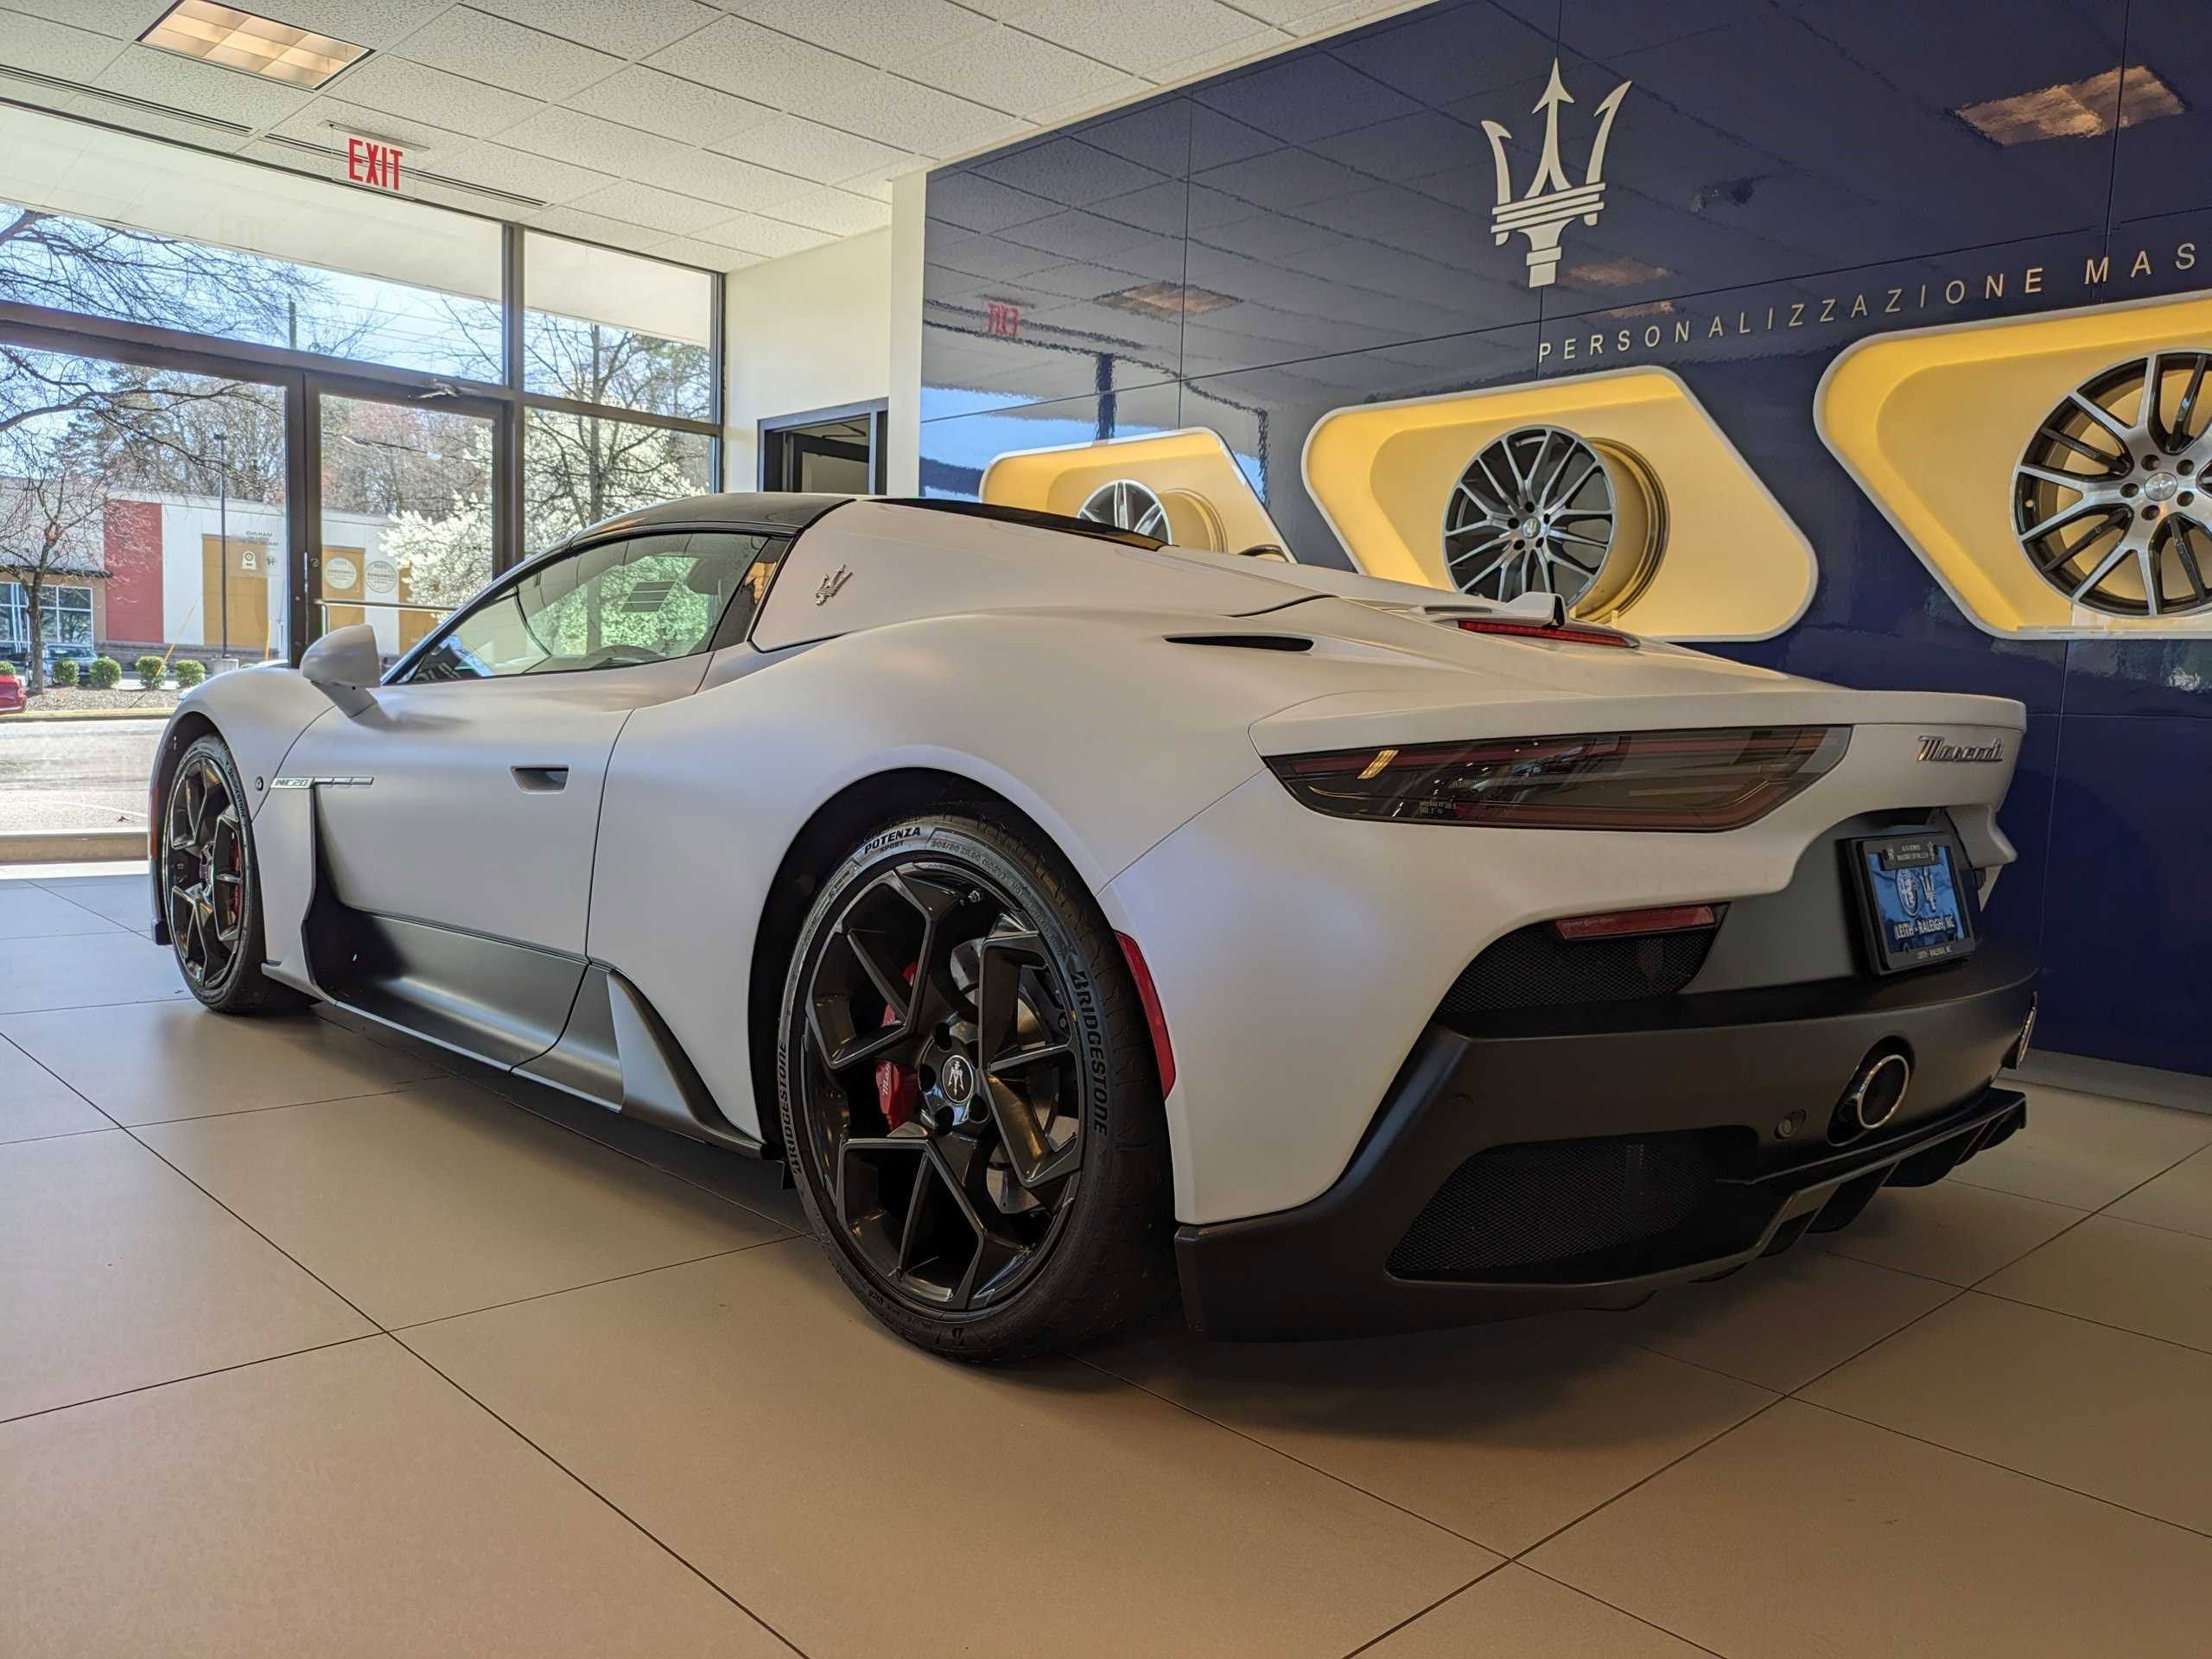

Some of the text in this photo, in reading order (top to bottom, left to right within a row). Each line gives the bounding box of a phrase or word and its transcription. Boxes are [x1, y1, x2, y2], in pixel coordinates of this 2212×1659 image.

[349, 138, 403, 191] EXIT
[1539, 243, 2196, 363] PERSONALIZZAZIONE MAS
[864, 826, 921, 855] POTENZA
[880, 840, 905, 852] SPORT
[1070, 969, 1109, 1136] BRIDGESTONE
[779, 1040, 802, 1176] BRIDGESTONE
